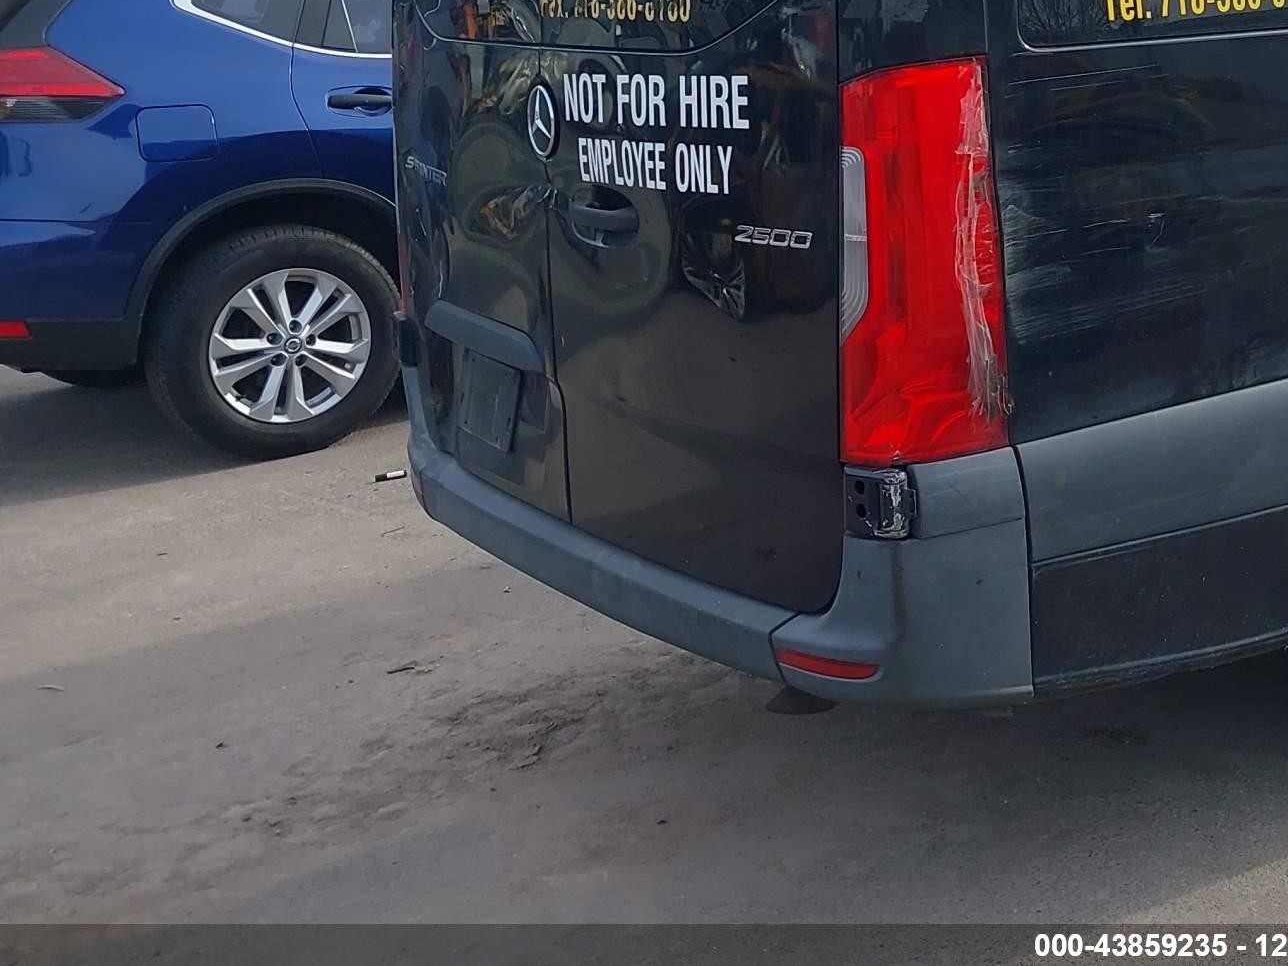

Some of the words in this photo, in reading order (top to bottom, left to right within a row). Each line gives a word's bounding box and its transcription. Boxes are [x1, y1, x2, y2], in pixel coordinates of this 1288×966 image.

[563, 73, 607, 123] NOT
[617, 74, 667, 127] FOR
[679, 75, 750, 130] HIRE
[578, 137, 667, 190] EMPLOYEE
[675, 143, 733, 195] ONLY
[734, 224, 814, 250] 2500
